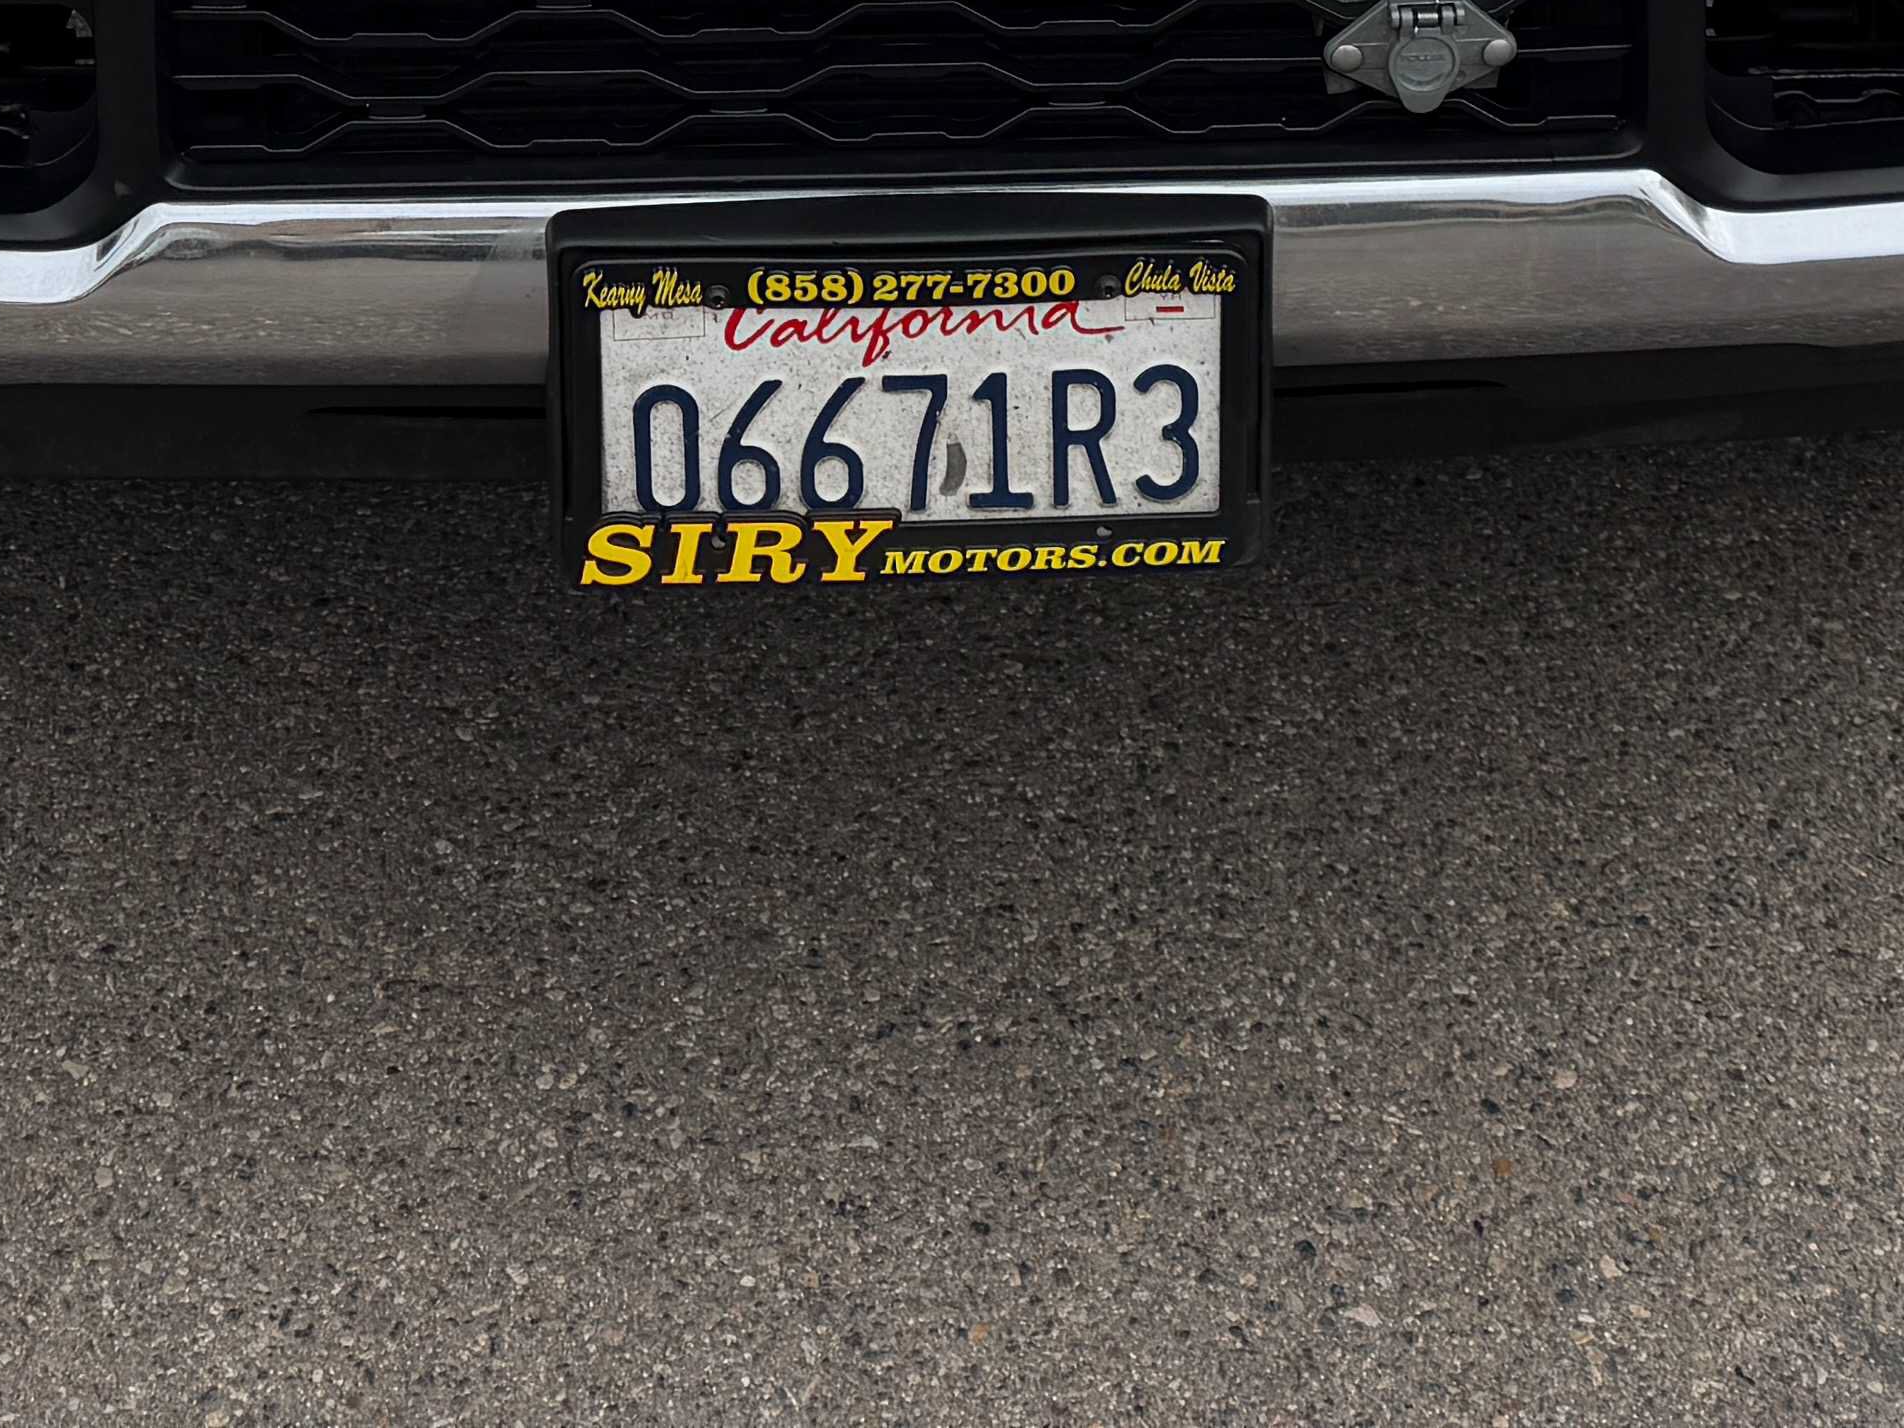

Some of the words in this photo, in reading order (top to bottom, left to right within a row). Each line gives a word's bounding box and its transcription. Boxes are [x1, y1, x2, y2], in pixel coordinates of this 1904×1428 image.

[583, 268, 647, 316] Kearny
[652, 268, 703, 306] Mesa
[746, 270, 863, 306] (858)
[871, 269, 1077, 302] 277-7300
[1124, 260, 1182, 296] Chula
[1189, 260, 1237, 293] Vista
[723, 299, 1125, 366] California
[633, 362, 1200, 512] 06671R3
[580, 518, 895, 586] SIRY
[879, 539, 1226, 576] MOTORS.COM
